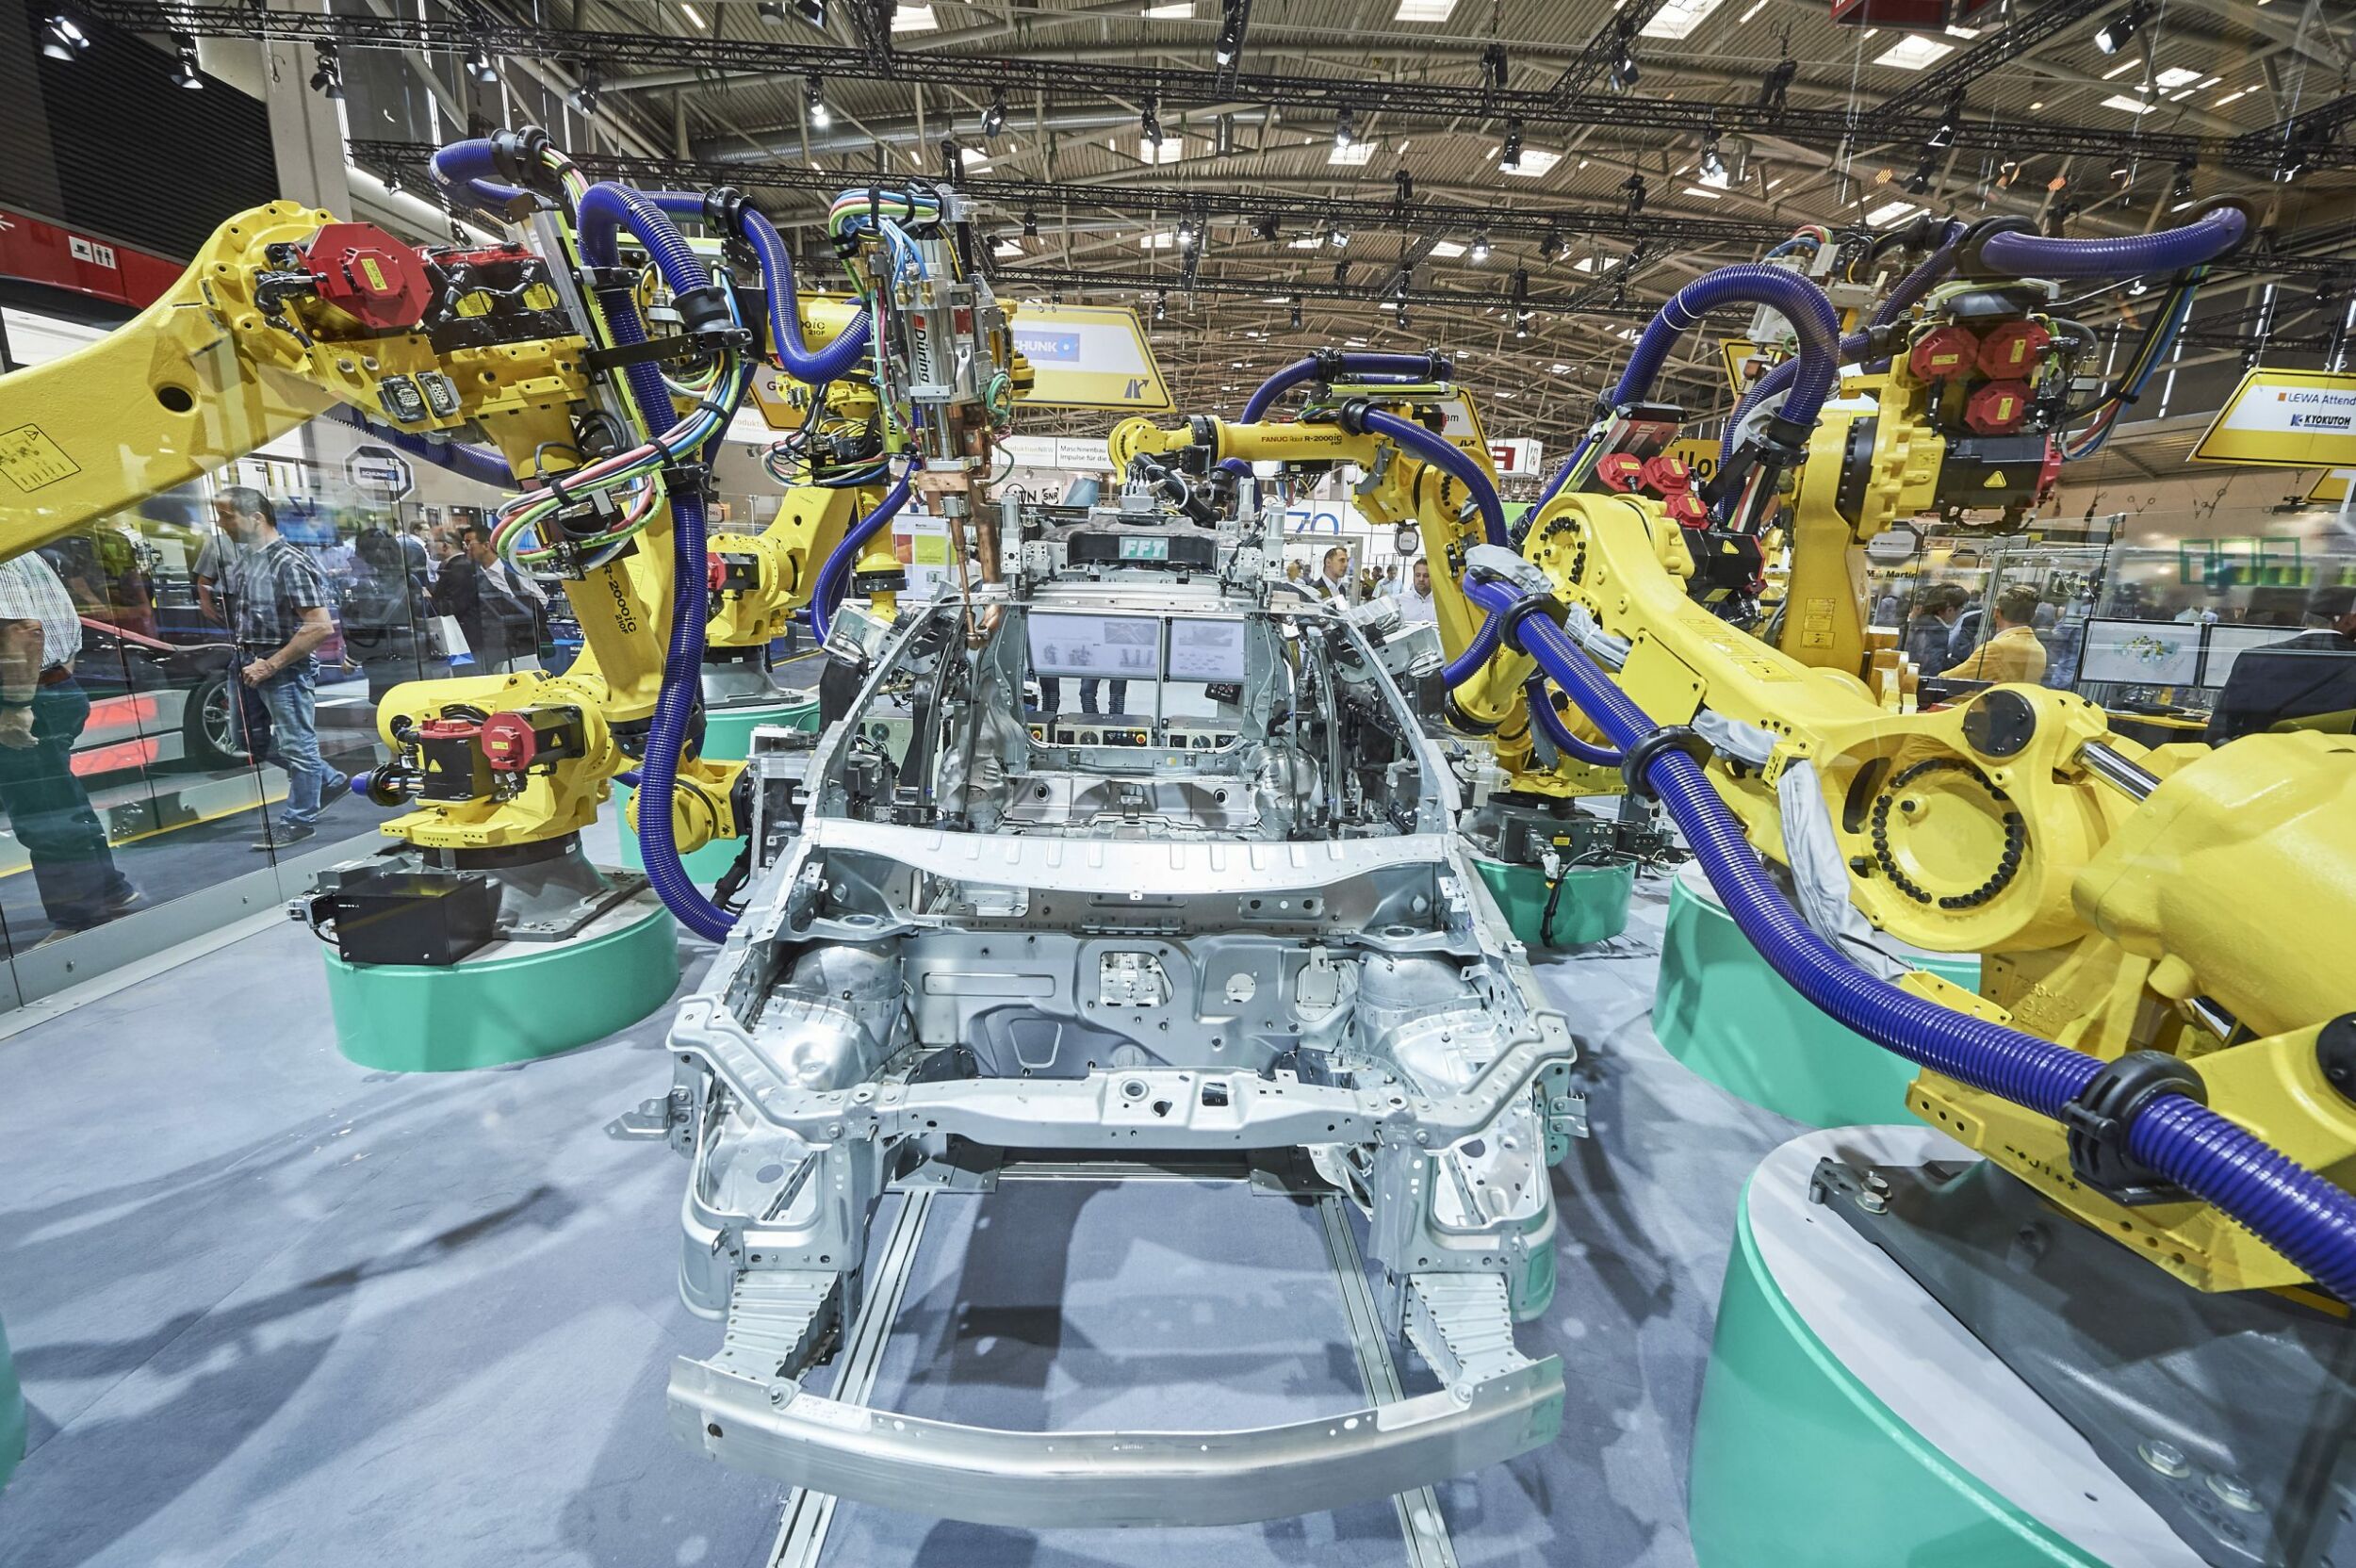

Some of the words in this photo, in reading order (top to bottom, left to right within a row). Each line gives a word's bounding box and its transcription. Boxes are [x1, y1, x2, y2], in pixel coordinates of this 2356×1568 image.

[1013, 340, 1058, 352] CHUNK
[913, 328, 931, 384] Düring
[2287, 392, 2319, 404] LEWA
[2304, 415, 2352, 426] KYOKUTOH
[1304, 433, 1343, 442] R-2000iC
[1059, 445, 1106, 454] Maschinenbau
[1059, 453, 1085, 462] Impulse
[1122, 539, 1166, 558] FFT
[602, 563, 638, 633] R-2000iC
[614, 614, 630, 635] 210F
